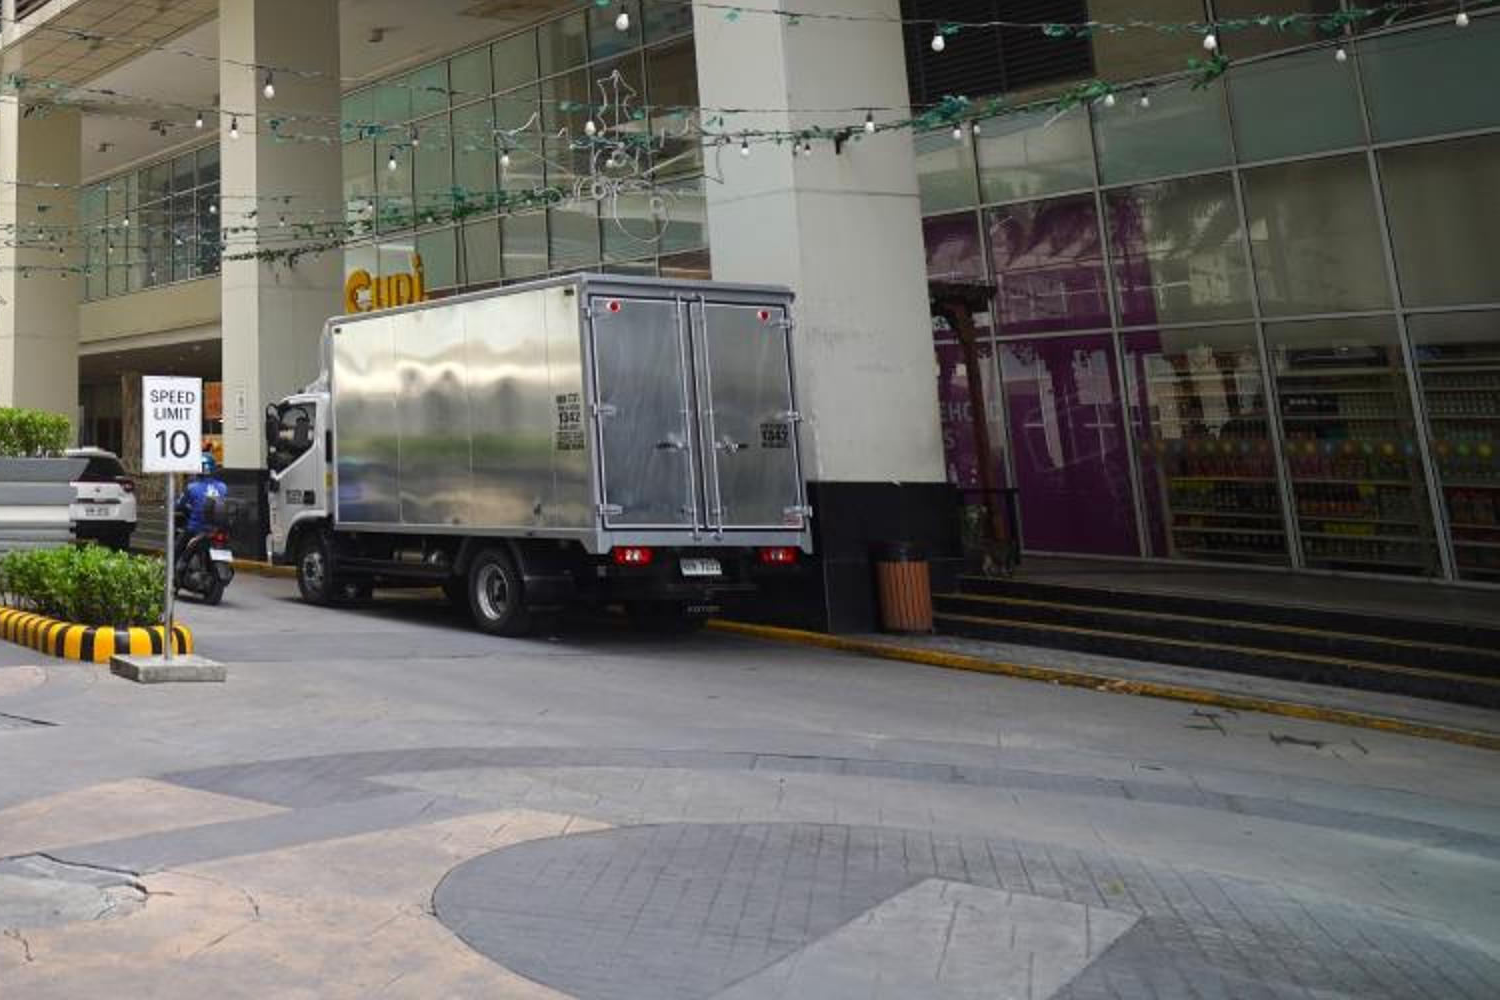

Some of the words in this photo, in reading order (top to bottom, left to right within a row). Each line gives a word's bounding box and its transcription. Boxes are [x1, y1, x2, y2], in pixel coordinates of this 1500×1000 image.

[150, 389, 196, 404] SPEED
[154, 407, 192, 421] LIMIT
[155, 429, 191, 459] 10
